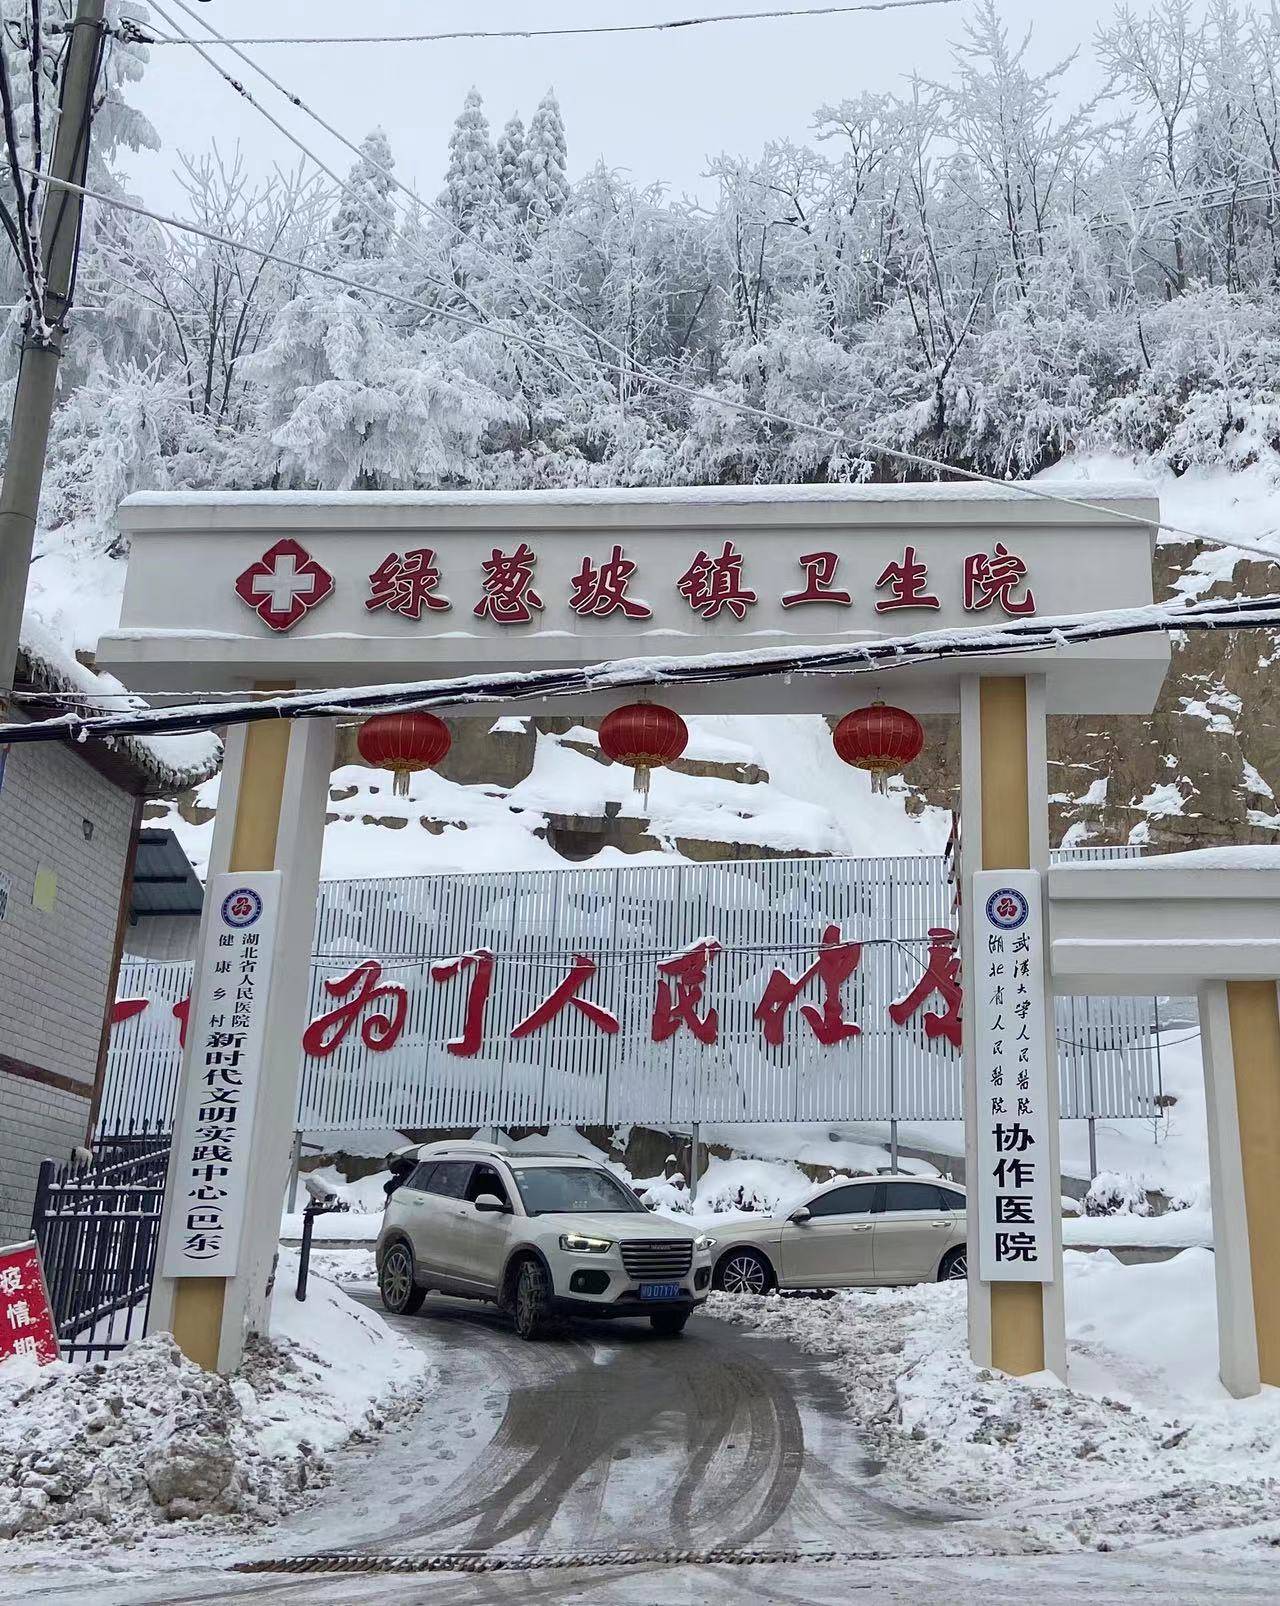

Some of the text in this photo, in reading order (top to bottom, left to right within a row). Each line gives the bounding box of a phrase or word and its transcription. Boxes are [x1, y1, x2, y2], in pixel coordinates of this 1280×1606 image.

[365, 540, 1037, 622] 绿葱坡镇卫生院
[208, 933, 234, 1028] 健康乡村
[230, 933, 261, 1028] 湖北省人民医院
[991, 1122, 1038, 1262] 协作医院
